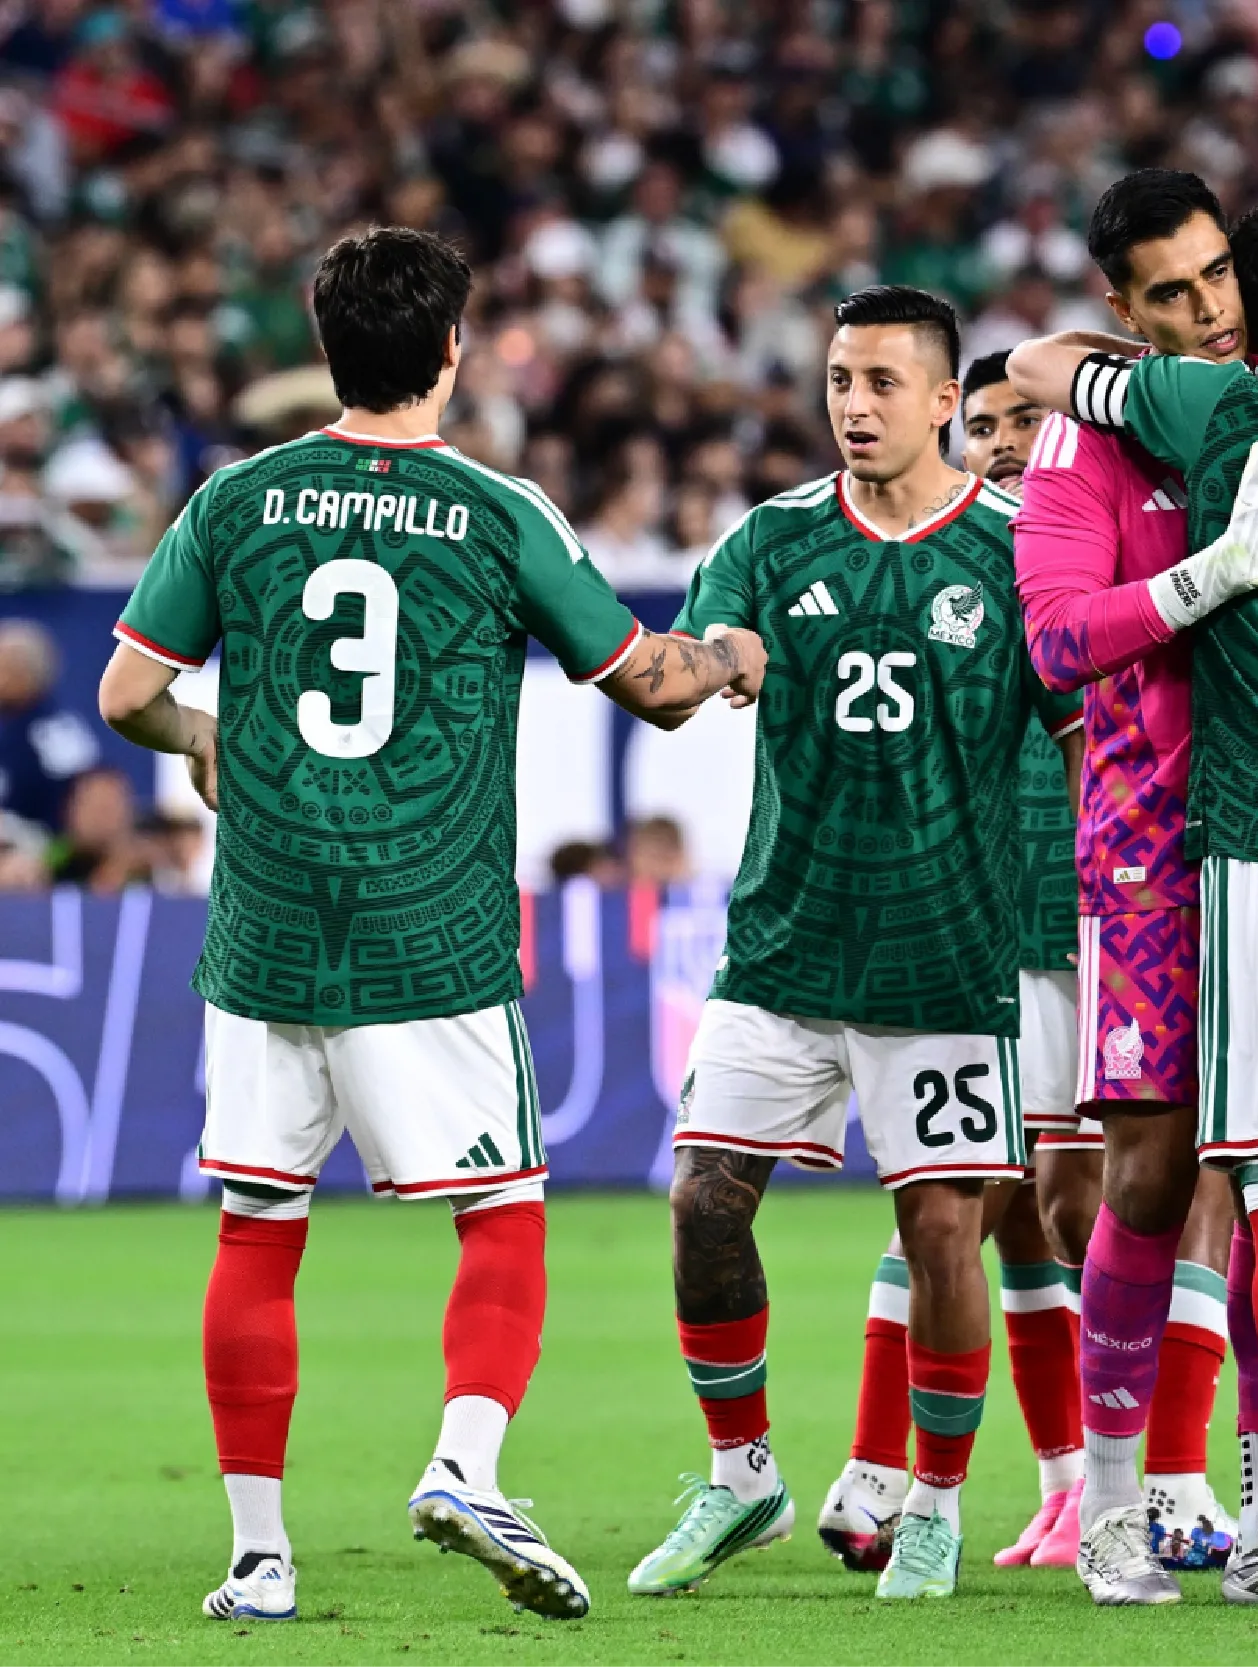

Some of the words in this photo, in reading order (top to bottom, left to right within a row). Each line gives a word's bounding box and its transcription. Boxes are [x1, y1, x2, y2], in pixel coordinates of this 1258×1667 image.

[297, 559, 399, 757] 3
[836, 653, 916, 731] 25
[914, 1063, 997, 1147] 25
